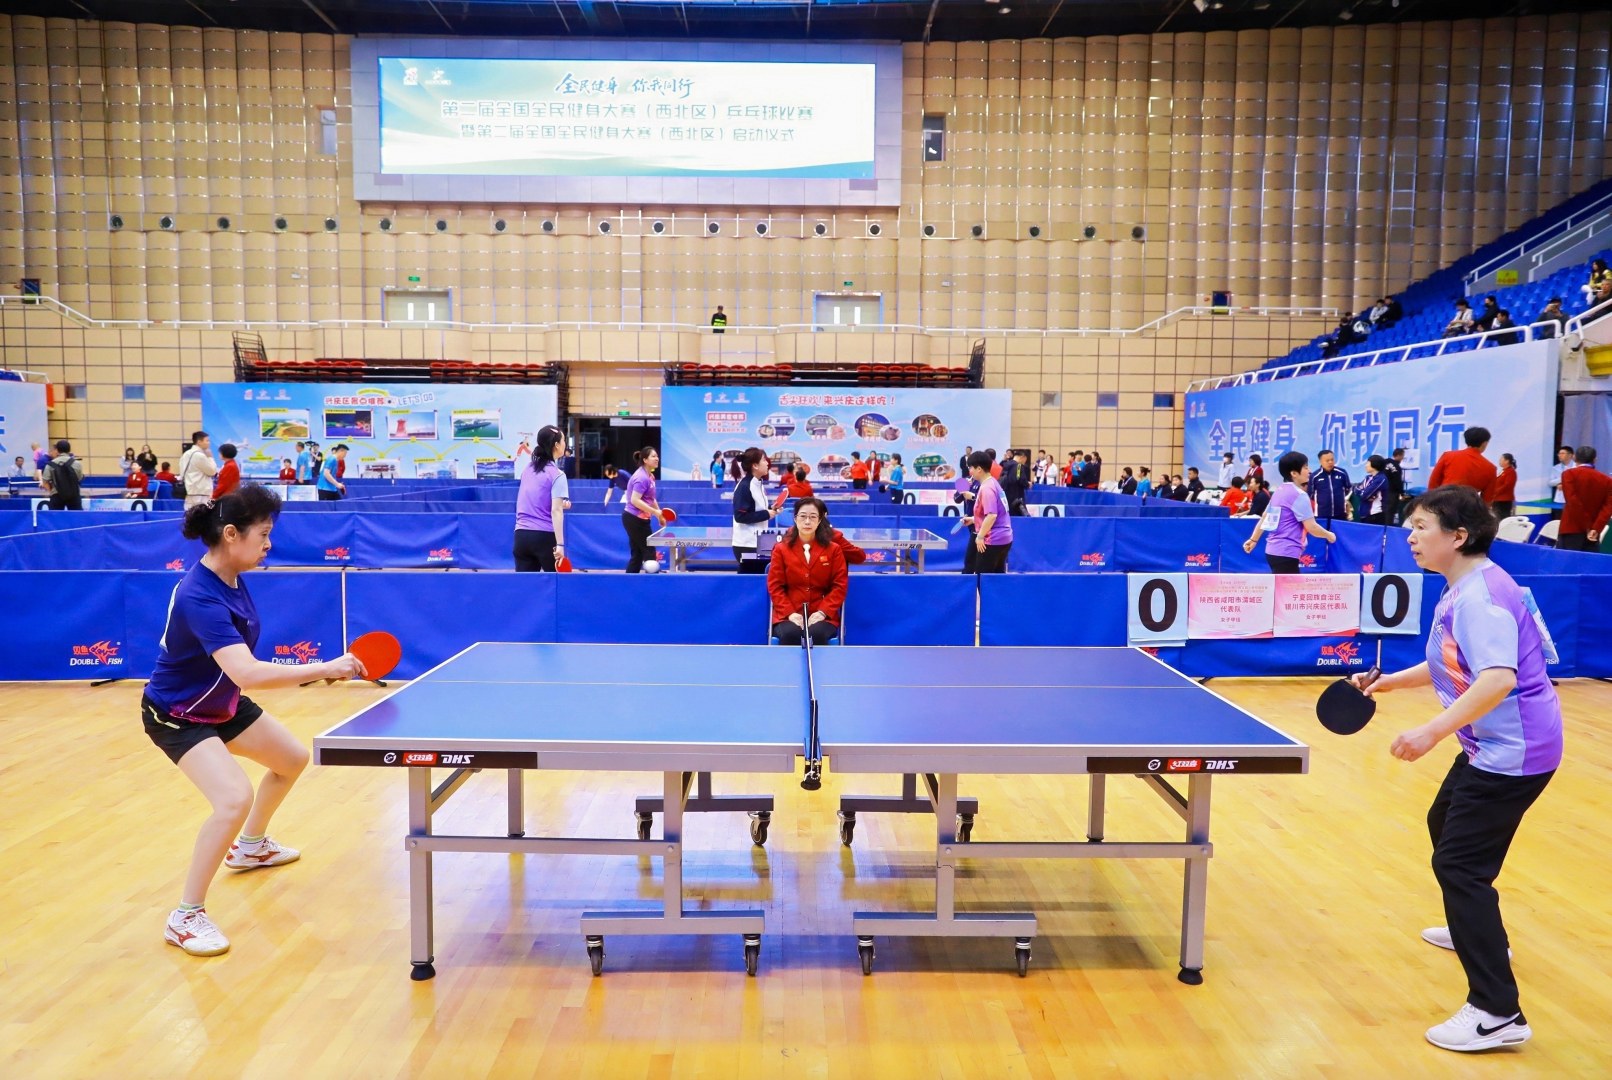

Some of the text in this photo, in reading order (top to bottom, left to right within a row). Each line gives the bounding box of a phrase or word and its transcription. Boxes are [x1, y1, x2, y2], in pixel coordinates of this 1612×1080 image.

[555, 73, 695, 99] 全民健身 你我同行
[398, 395, 421, 406] LET'S
[1208, 404, 1466, 467] 全民健身 你我同行
[1199, 596, 1263, 604] 陕西省咸阳市渭城区
[1292, 593, 1341, 601] 宁夏回族自治区
[1371, 574, 1410, 628] 0
[1138, 578, 1178, 632] 0
[1220, 605, 1242, 613] 代表队
[1284, 602, 1348, 611] 银川市兴庆区代表队
[70, 658, 100, 666] DOUBLE
[271, 657, 300, 665] DOUBLE
[1316, 658, 1342, 666] DOUBLE
[441, 754, 475, 764] DHS
[1205, 760, 1239, 770] DHS
